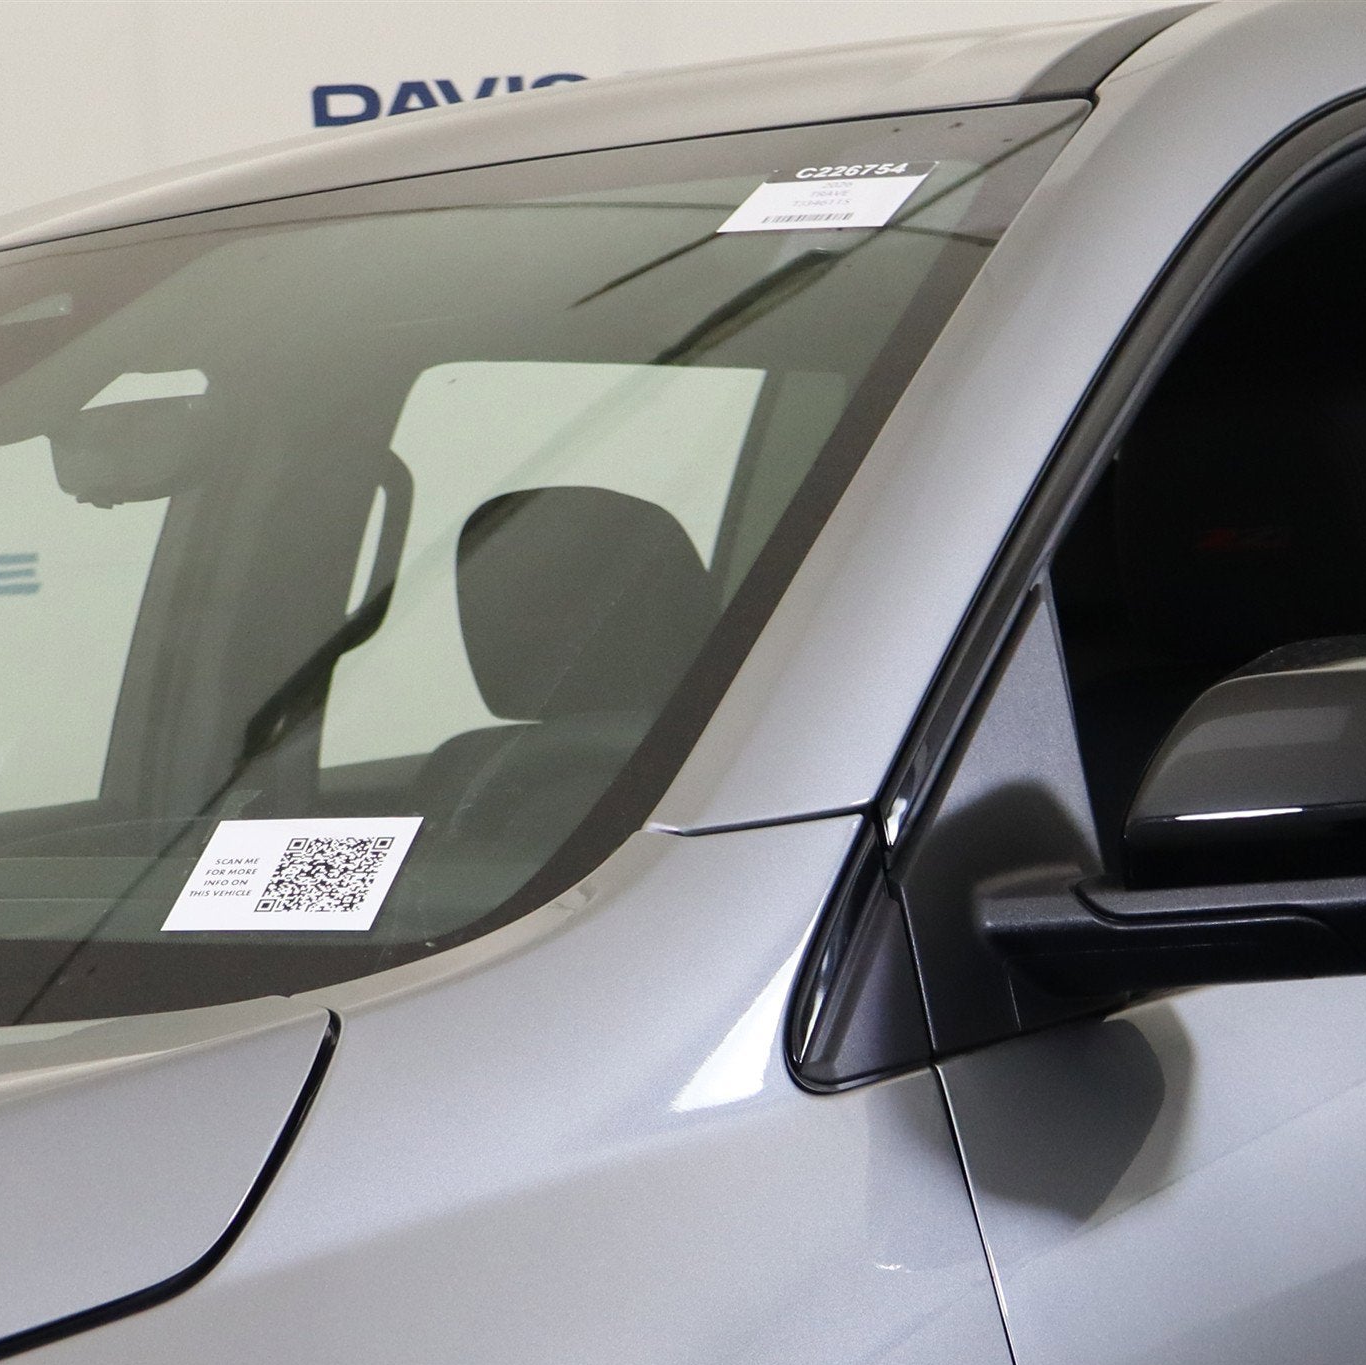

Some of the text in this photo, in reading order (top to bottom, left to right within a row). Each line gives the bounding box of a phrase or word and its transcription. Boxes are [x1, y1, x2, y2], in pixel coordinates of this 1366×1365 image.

[311, 73, 590, 128] DAV
[795, 162, 909, 179] C226754
[244, 857, 260, 865] ME
[213, 889, 252, 897] VEHICLE
